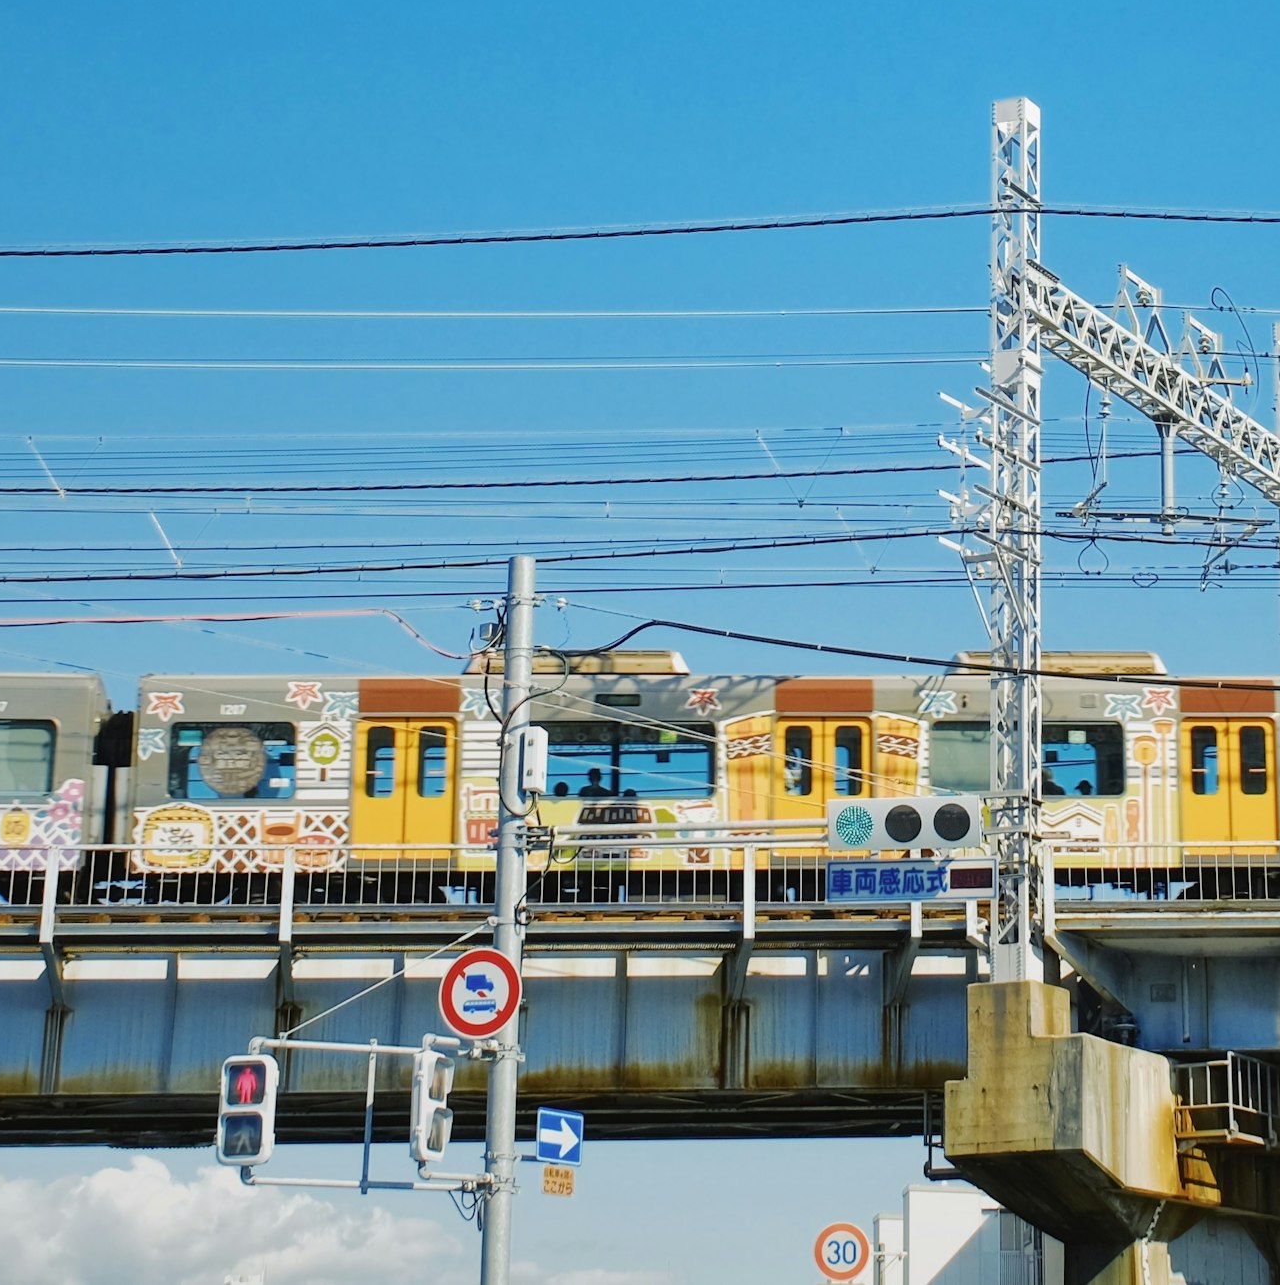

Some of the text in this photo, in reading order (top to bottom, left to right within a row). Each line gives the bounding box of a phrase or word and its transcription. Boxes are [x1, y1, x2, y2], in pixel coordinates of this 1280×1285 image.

[831, 866, 948, 896] 車両感応式
[544, 1180, 573, 1195] ここから
[827, 1240, 856, 1264] 30
